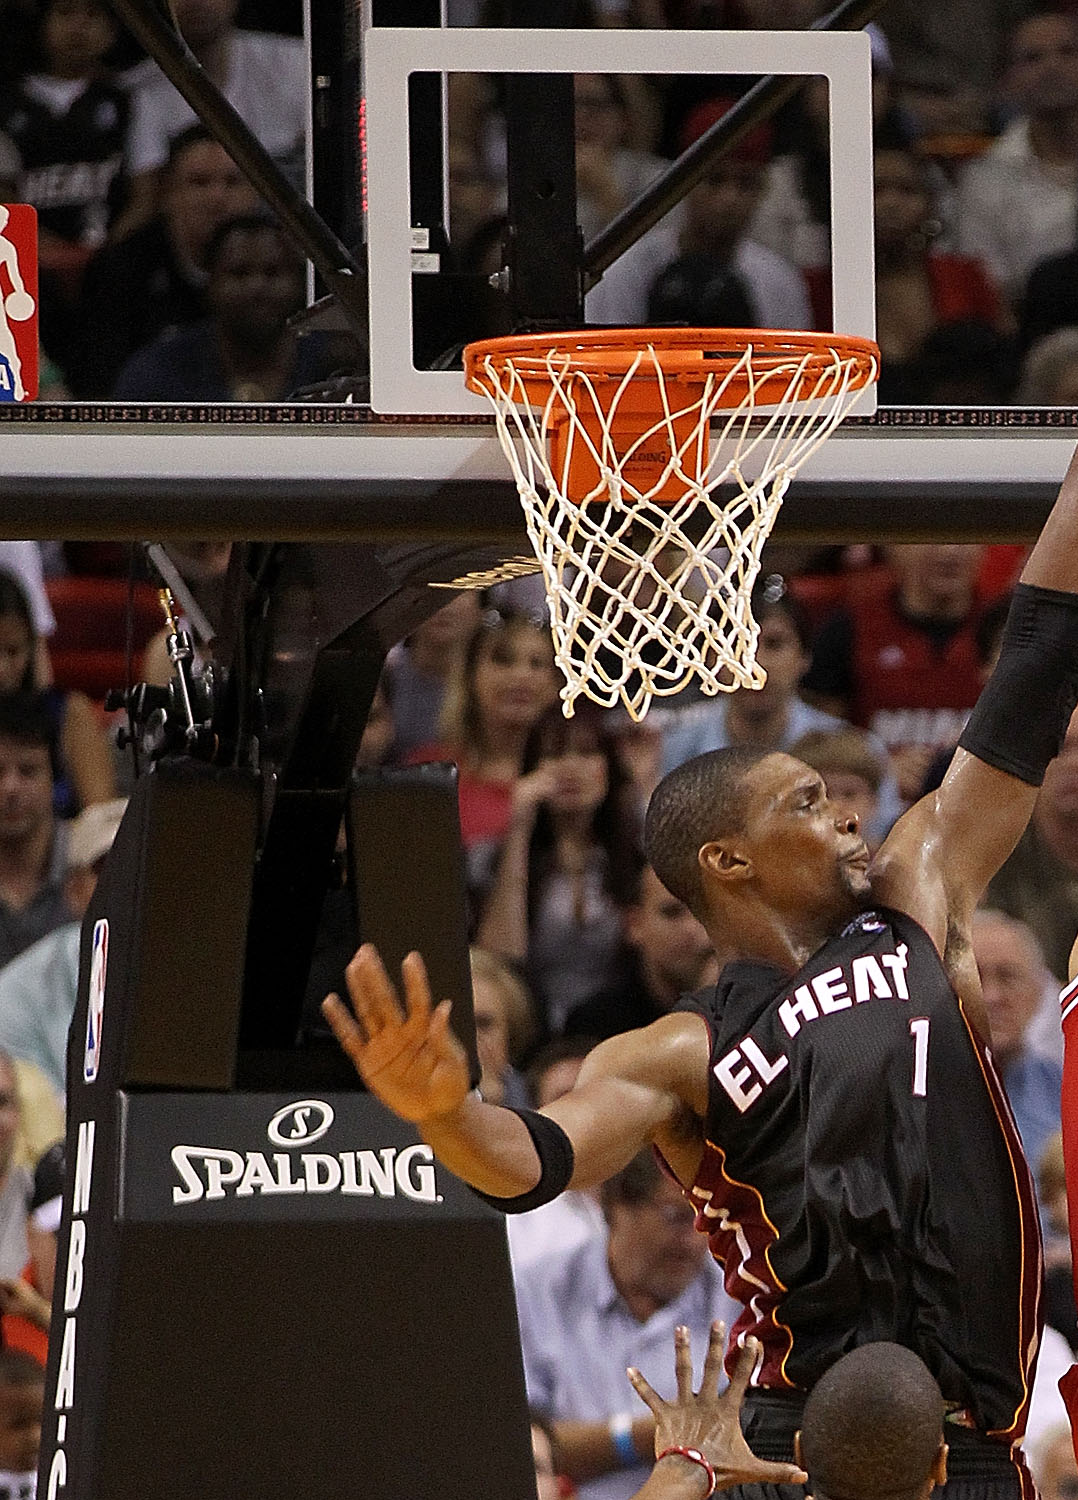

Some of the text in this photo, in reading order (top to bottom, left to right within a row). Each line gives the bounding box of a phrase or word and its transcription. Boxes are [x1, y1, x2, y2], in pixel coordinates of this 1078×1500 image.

[713, 942, 910, 1114] EL HEAT
[908, 1015, 931, 1098] 1
[170, 1144, 440, 1206] SPALDING
